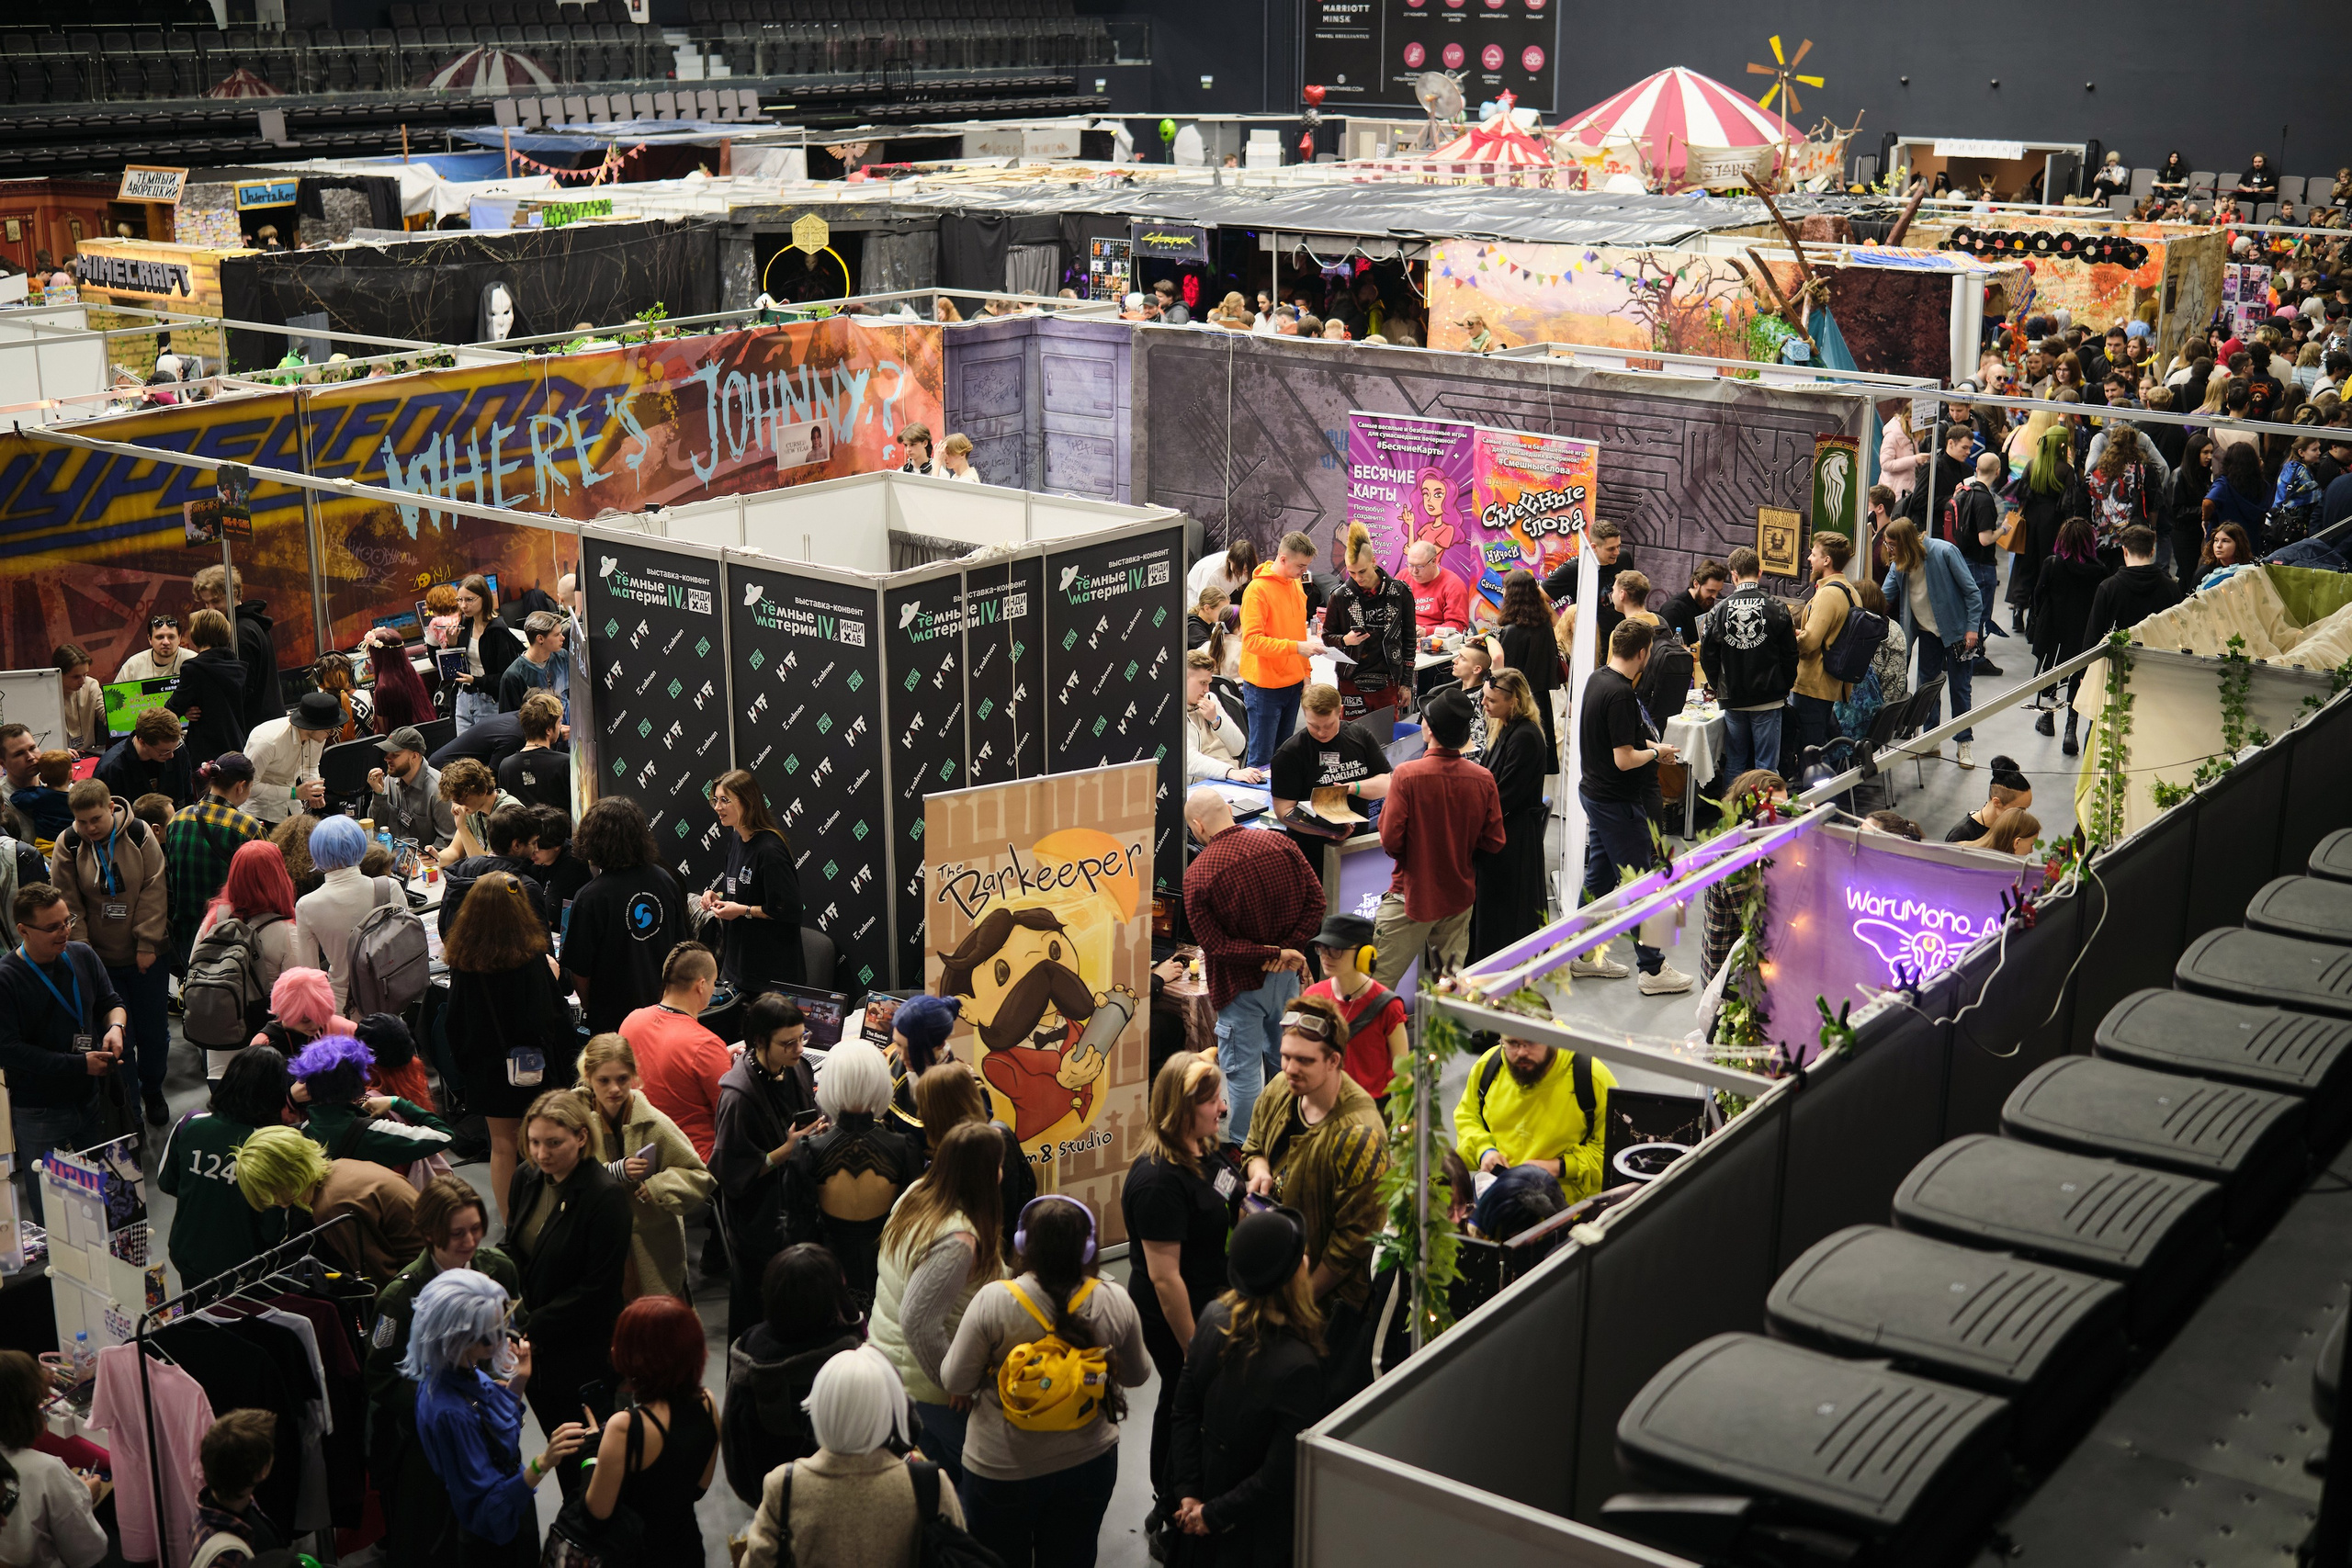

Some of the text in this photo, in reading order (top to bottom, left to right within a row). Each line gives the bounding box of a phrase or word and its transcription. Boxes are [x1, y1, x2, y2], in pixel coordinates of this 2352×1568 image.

[1323, 5, 1371, 13] MARRIOTT
[1323, 15, 1351, 23] MINSK
[1446, 51, 1461, 60] VIP
[137, 172, 176, 186] ТЁМНЫЙ
[127, 181, 180, 199] ДВОРЕЦКИЙ
[76, 254, 191, 298] MINECRAFT
[1358, 421, 1377, 430] Самые
[1378, 423, 1401, 432] веселые
[1408, 425, 1449, 436] безбашенные
[1450, 430, 1467, 439] игры
[1379, 433, 1420, 442] сумасшедших
[1422, 435, 1456, 446] вечеринок!
[1376, 441, 1444, 457] #БесячиеКарты
[1482, 436, 1499, 446] Самые
[1502, 439, 1525, 448] веселые
[1532, 442, 1573, 455] безбашенные
[1574, 448, 1590, 457] игры
[1503, 447, 1544, 458] сумасшедших
[382, 393, 652, 542] WHERE'S
[1353, 465, 1416, 484] БЕСЯЧИЕ
[1498, 457, 1570, 476] #СмешныеСлова
[1353, 483, 1396, 502] КАРТЫ
[1484, 477, 1527, 491] ФАНТЫ
[1353, 503, 1385, 513] Попробуй
[1353, 513, 1385, 522] сохранить
[1374, 540, 1393, 548] будут
[1108, 548, 1170, 568] выставка-конвент
[646, 568, 710, 586] выставка-конвент
[1148, 562, 1169, 575] ИНДИ
[616, 571, 665, 592] тёмные
[1071, 583, 1128, 605] материи
[1128, 567, 1144, 592] IV
[1076, 570, 1126, 592] тёмные
[611, 586, 668, 606] материи
[667, 584, 684, 609] IV
[689, 591, 710, 603] ИНДИ
[761, 600, 815, 624] тёмные
[795, 597, 865, 616] выставка-конвент
[980, 599, 999, 626] IV
[757, 615, 818, 637] материи
[818, 615, 835, 640] IV
[841, 621, 865, 634] ИНДИ
[1126, 608, 1143, 634] zalman
[668, 629, 684, 649] zalman
[1724, 632, 1768, 650] BAD BASTARDS
[979, 643, 997, 671] zalman
[641, 671, 656, 690] zalman
[818, 661, 834, 682] zalman
[1098, 663, 1114, 689] zalman
[787, 705, 804, 725] zalman
[1155, 694, 1170, 719] zalman
[613, 710, 627, 729] zalman
[944, 703, 961, 730] zalman
[702, 731, 718, 750] zalman
[1066, 718, 1081, 744] zalman
[756, 745, 772, 765] zalman
[675, 772, 690, 791] zalman
[854, 769, 870, 789] zalman
[910, 762, 927, 791] zalman
[823, 810, 840, 829] zalman
[937, 842, 1142, 923] The Barkeeper
[859, 917, 876, 935] zalman
[188, 1149, 237, 1185] 124
